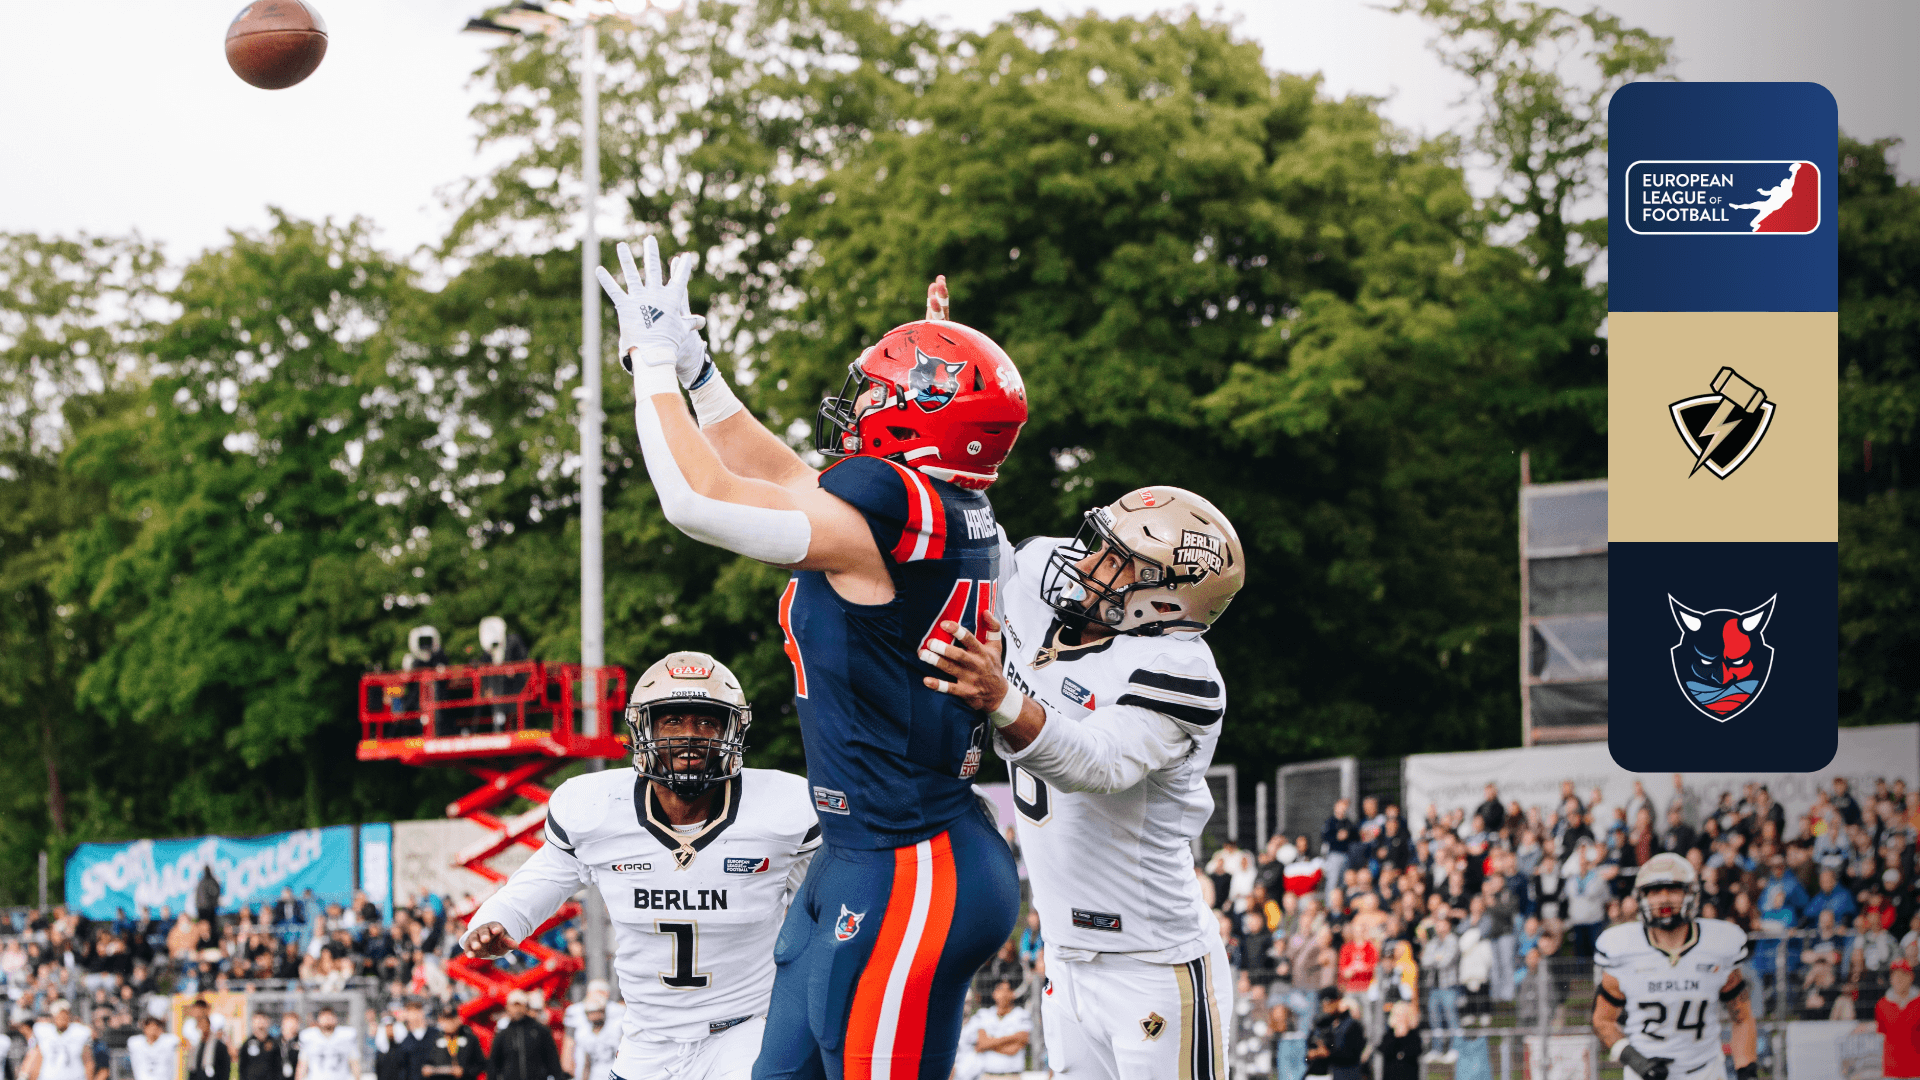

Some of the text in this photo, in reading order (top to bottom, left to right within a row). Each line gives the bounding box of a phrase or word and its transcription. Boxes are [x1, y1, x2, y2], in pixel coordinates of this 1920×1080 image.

[639, 304, 653, 330] adidas
[968, 444, 981, 453] 44
[1183, 531, 1220, 556] BERLIN
[1177, 548, 1222, 574] THUNDER
[672, 666, 709, 676] GAZI
[634, 888, 728, 911] BERLIN
[655, 919, 712, 990] 1
[1648, 980, 1700, 993] BERLIN
[1638, 1000, 1708, 1041] 24
